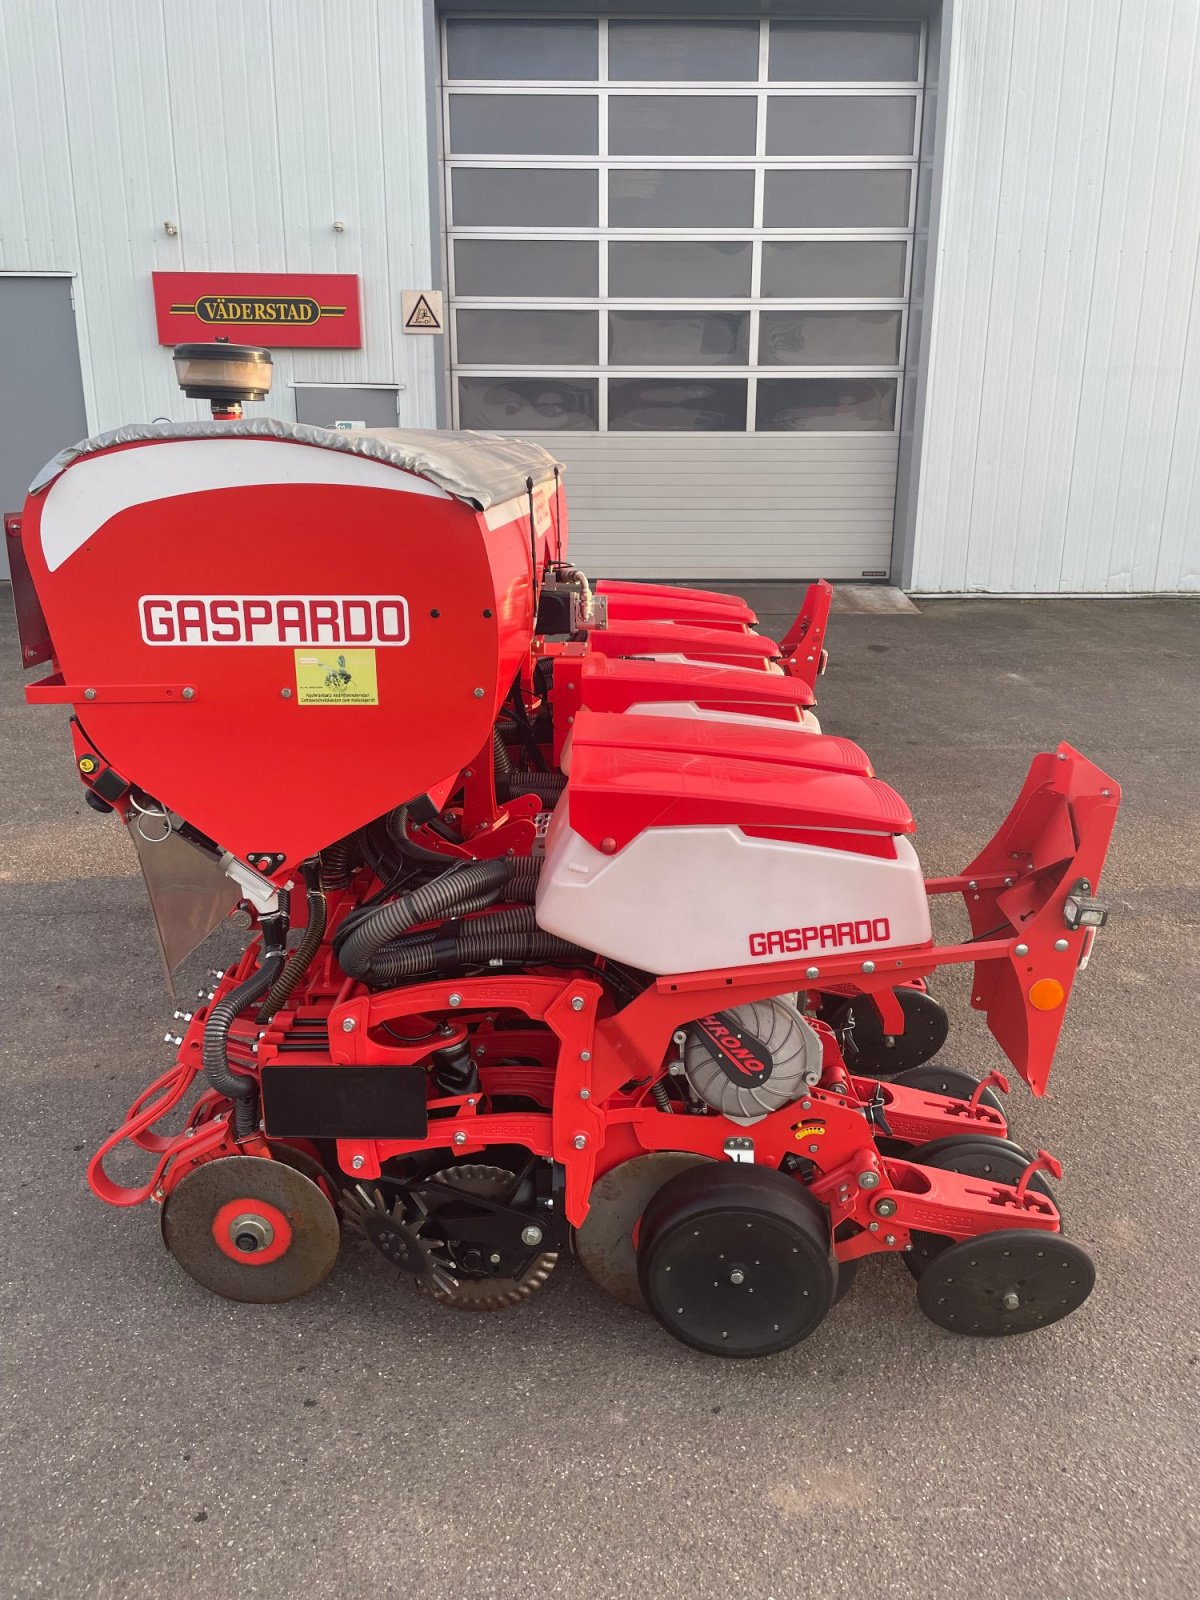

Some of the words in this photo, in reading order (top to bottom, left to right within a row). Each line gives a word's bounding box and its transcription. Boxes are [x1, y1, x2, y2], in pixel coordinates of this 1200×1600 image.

[203, 298, 312, 321] VÄDERSTAD
[143, 599, 406, 642] GASPARDO
[748, 917, 891, 957] GASPARDO
[699, 1014, 765, 1073] HRONO
